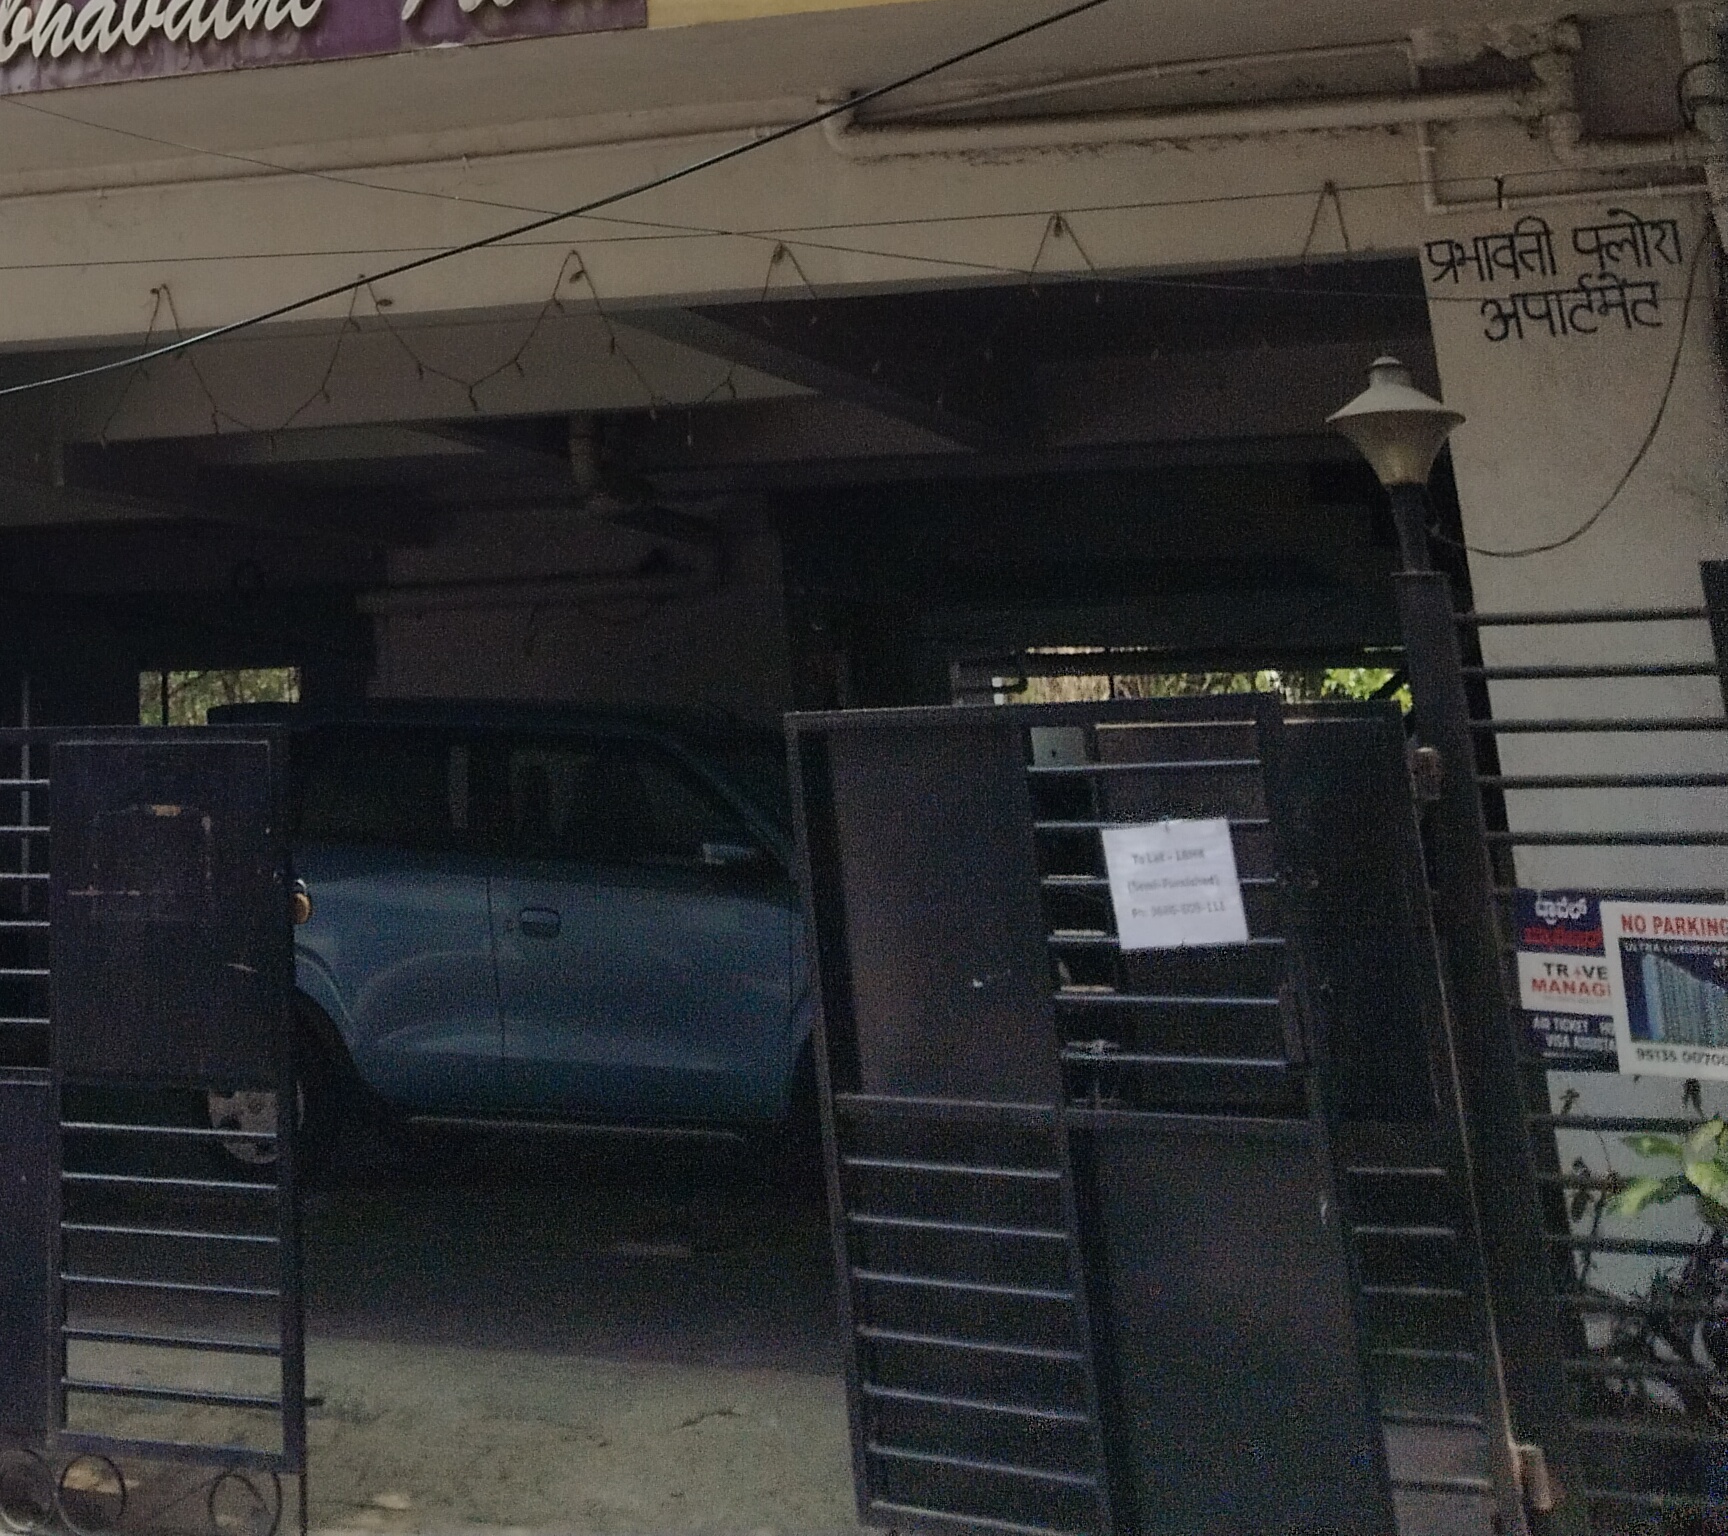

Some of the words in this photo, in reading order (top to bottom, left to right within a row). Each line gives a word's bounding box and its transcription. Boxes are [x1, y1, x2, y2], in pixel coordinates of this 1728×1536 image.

[1425, 215, 1556, 283] प्रभावती
[1621, 914, 1646, 933] NO
[1532, 978, 1612, 997] MANAG
